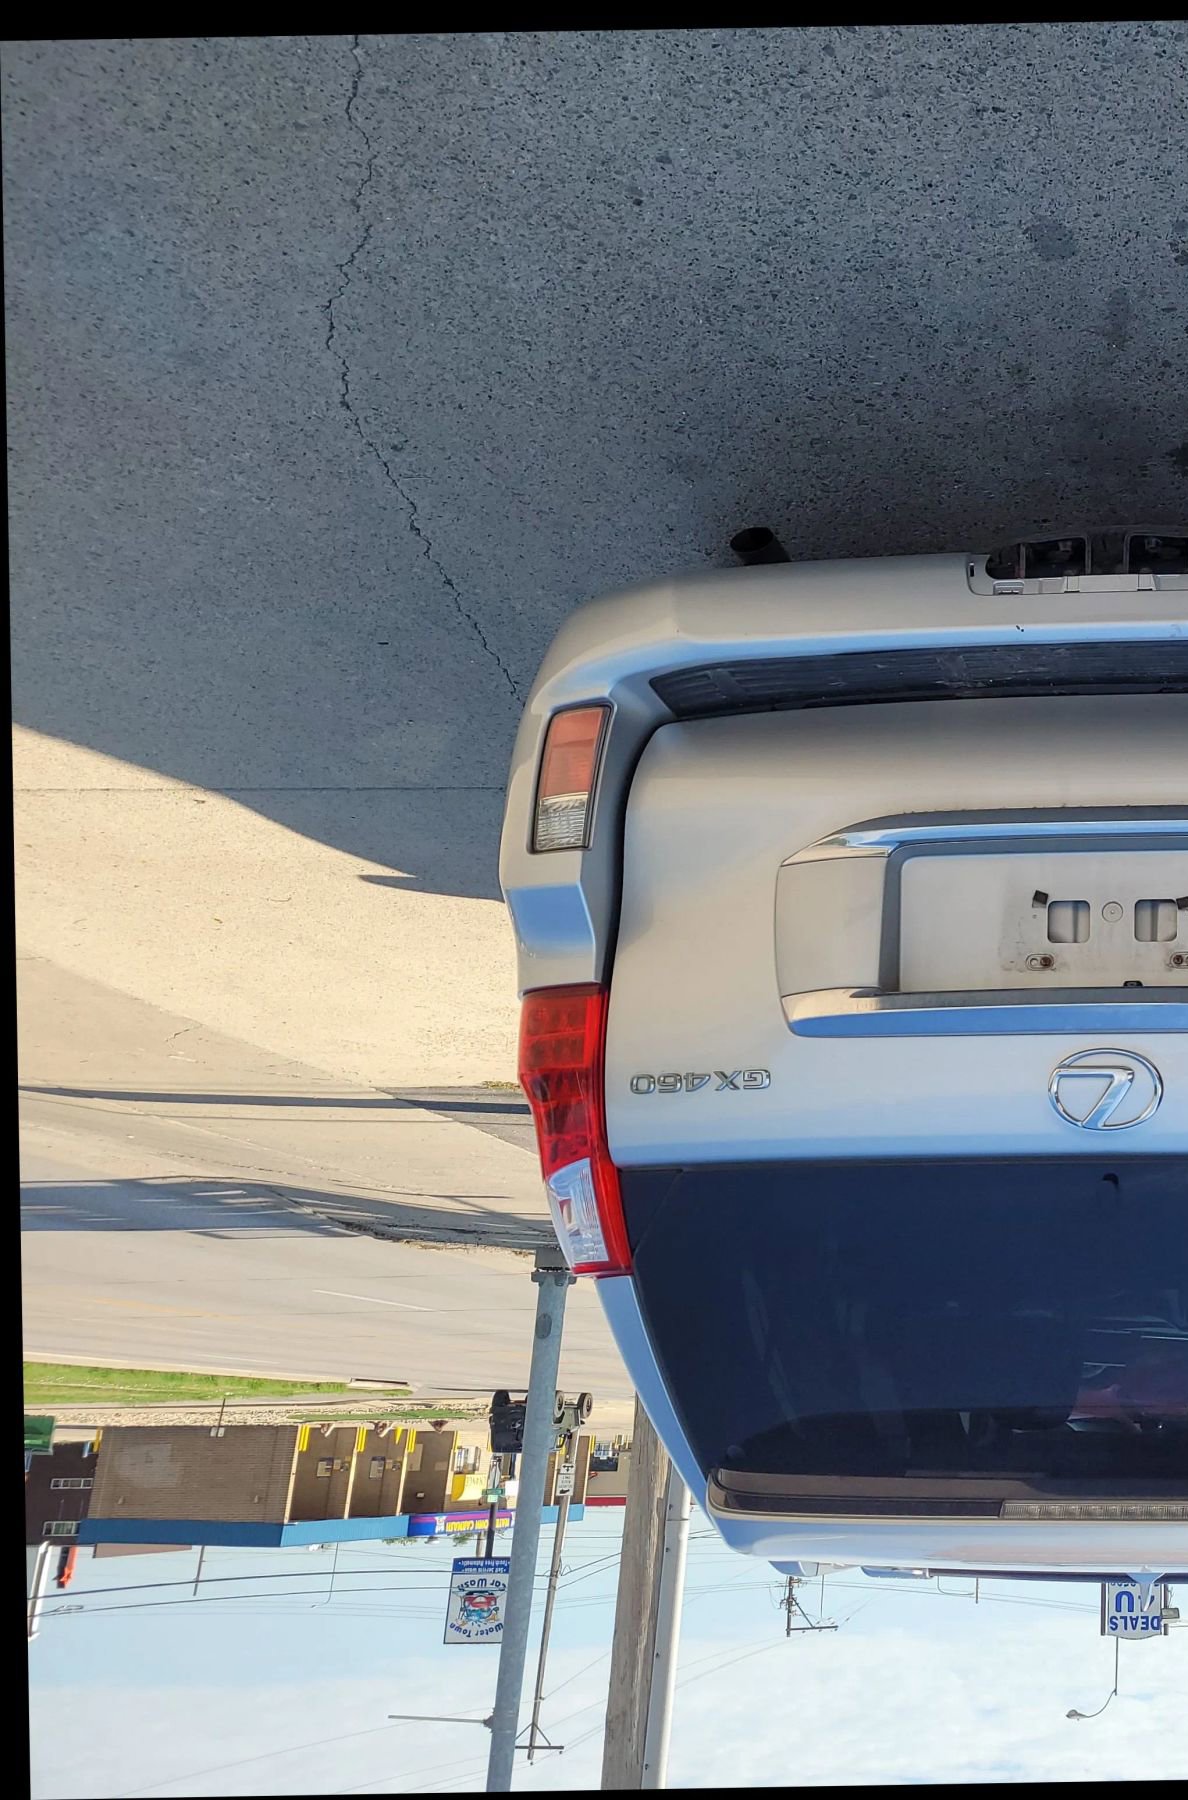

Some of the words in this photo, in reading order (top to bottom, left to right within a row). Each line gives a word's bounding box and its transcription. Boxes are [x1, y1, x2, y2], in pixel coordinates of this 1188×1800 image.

[456, 1578, 487, 1592] Wash
[490, 1580, 506, 1592] Car
[1115, 1590, 1135, 1613] U
[449, 1622, 472, 1638] Town
[1109, 1615, 1161, 1631] DEALS
